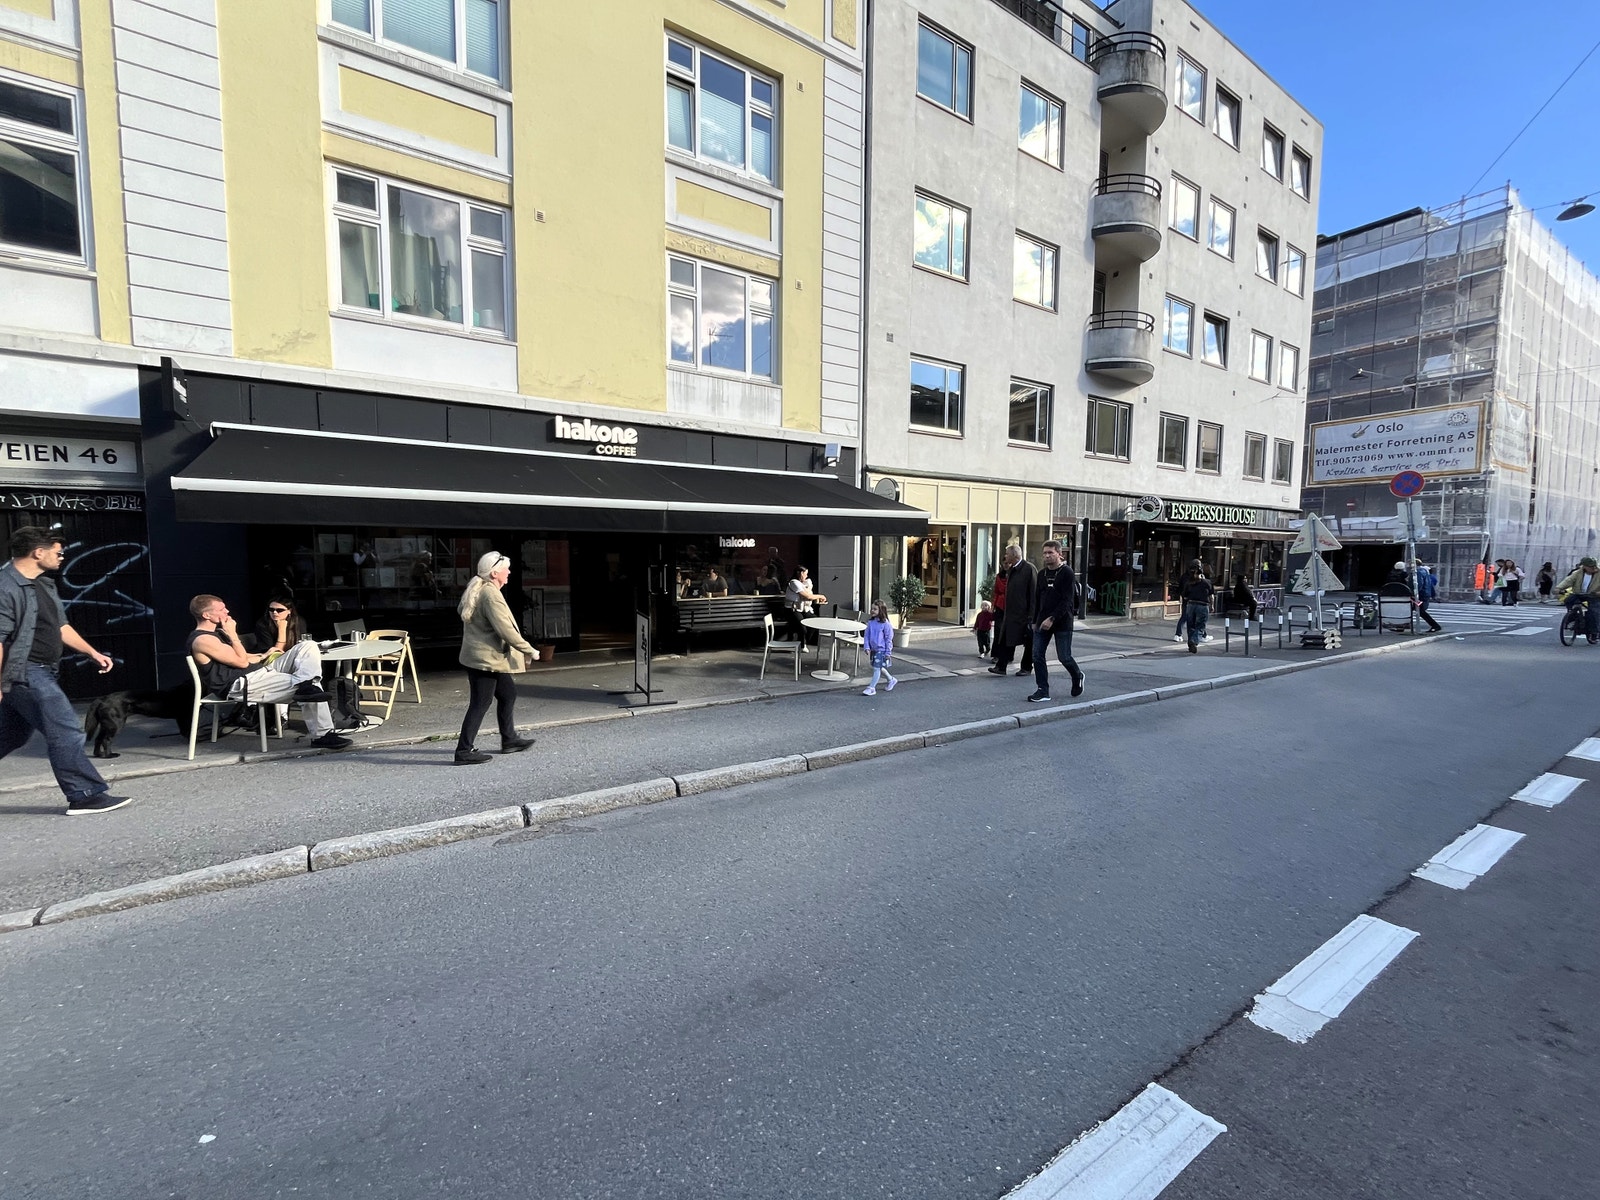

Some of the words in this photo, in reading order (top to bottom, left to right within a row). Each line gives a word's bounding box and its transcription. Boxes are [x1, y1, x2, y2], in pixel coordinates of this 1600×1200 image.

[555, 415, 638, 445] hakone
[1376, 422, 1403, 434] Oslo
[1315, 442, 1384, 456] Malermester
[1387, 433, 1454, 448] Forretning
[1457, 430, 1475, 440] AS
[0, 442, 69, 463] EIEN
[78, 447, 118, 464] 46
[595, 444, 637, 457] COFFEE
[1387, 446, 1474, 460] www.ommf.no
[1415, 461, 1432, 471] og
[1170, 502, 1223, 522] ESPRESSO
[1224, 507, 1256, 524] HOUSE
[719, 536, 756, 548] hakone
